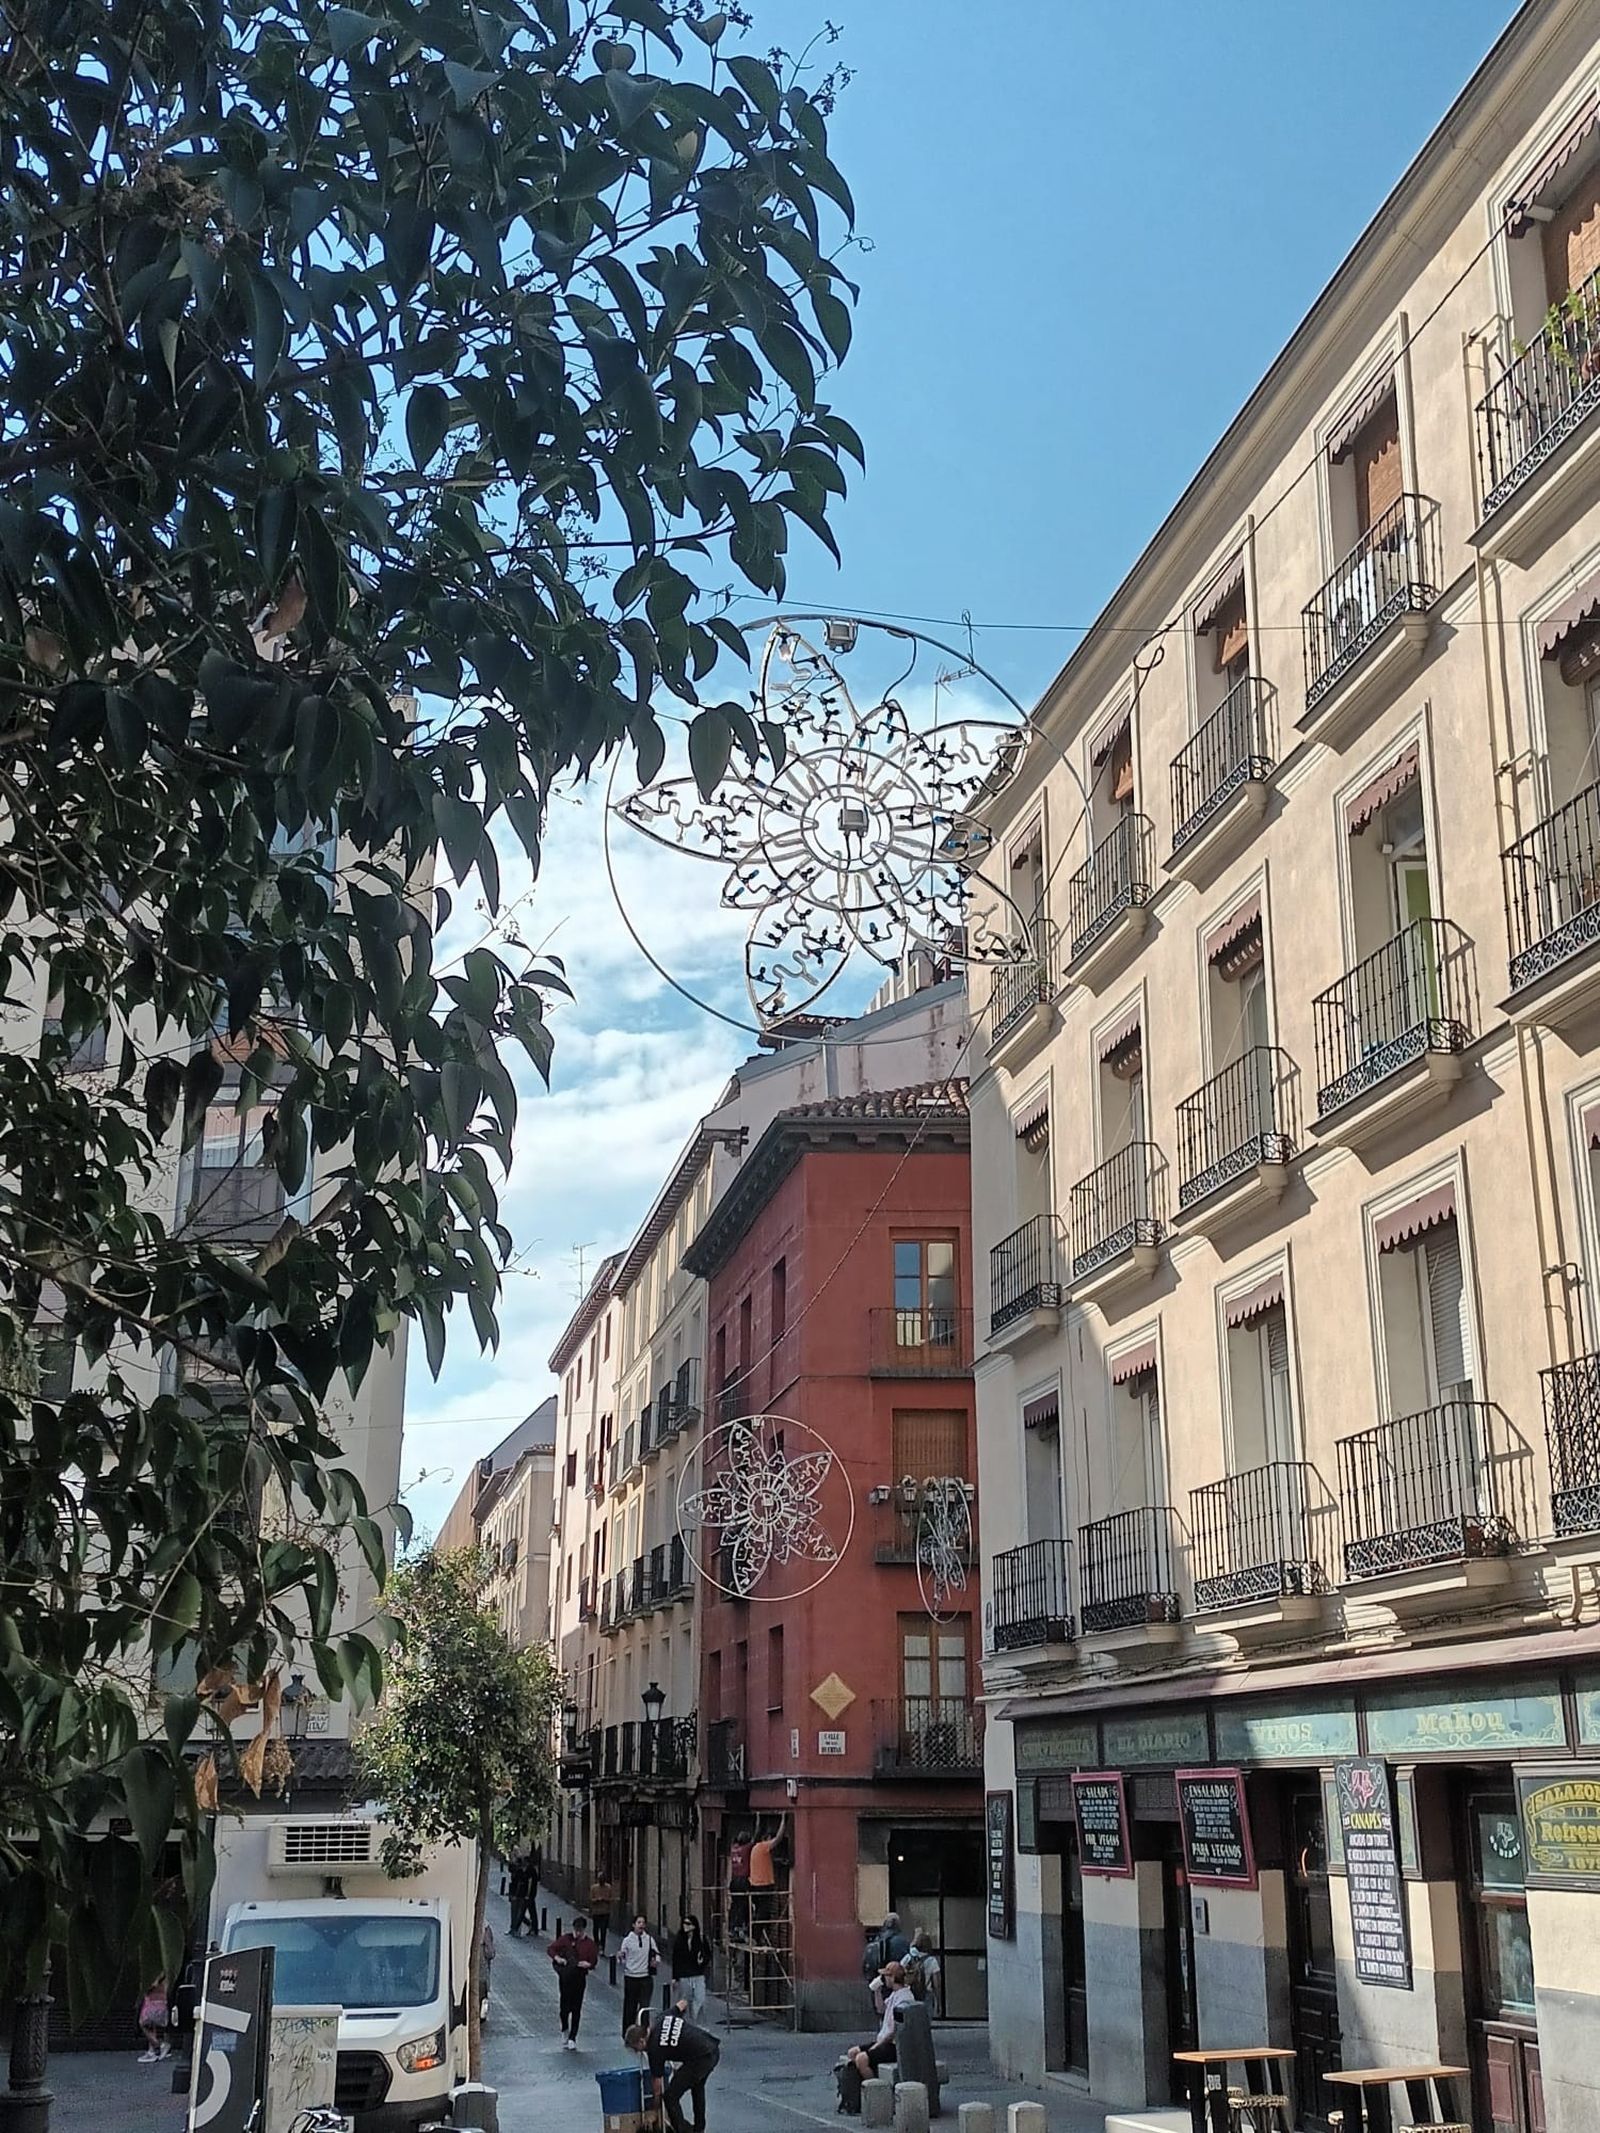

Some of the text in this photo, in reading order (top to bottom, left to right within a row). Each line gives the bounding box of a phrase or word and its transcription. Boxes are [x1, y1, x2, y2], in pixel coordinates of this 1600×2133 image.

[1416, 1709, 1505, 1734] Mahou
[1138, 1732, 1190, 1750] DIARIO
[1253, 1722, 1312, 1742] VINOS
[1189, 1785, 1229, 1798] ENSALADAS
[1350, 1811, 1382, 1829] CANAPÉS
[1191, 1843, 1242, 1859] PARA VEGANOS
